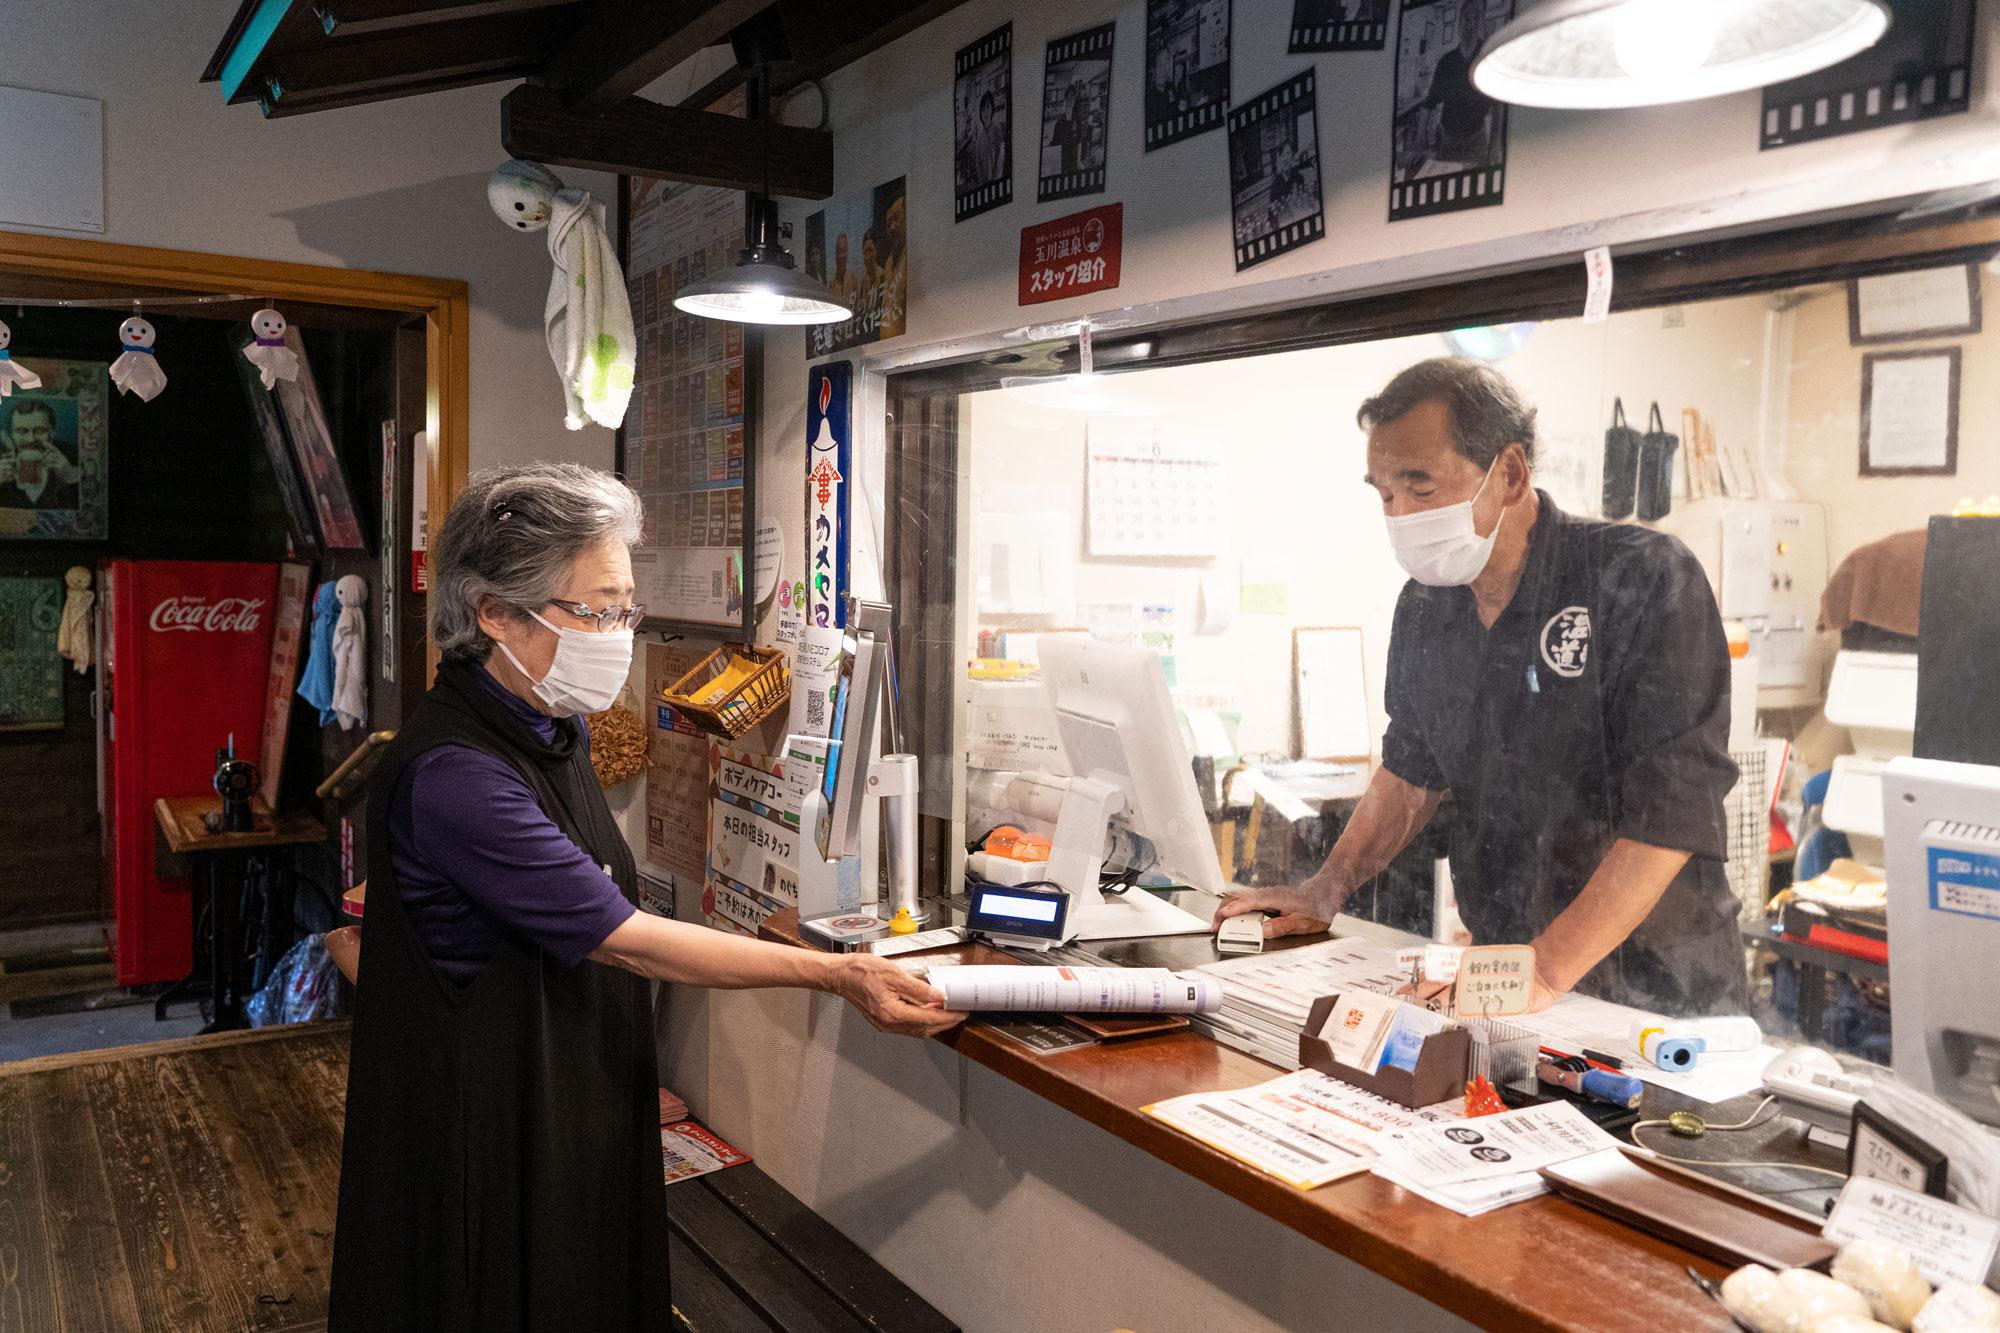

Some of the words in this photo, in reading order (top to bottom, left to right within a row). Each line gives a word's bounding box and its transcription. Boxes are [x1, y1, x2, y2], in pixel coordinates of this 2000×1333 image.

[1034, 236, 1082, 264] 玉川温泉
[1030, 256, 1107, 293] スタッフ紹介
[815, 514, 831, 628] カメヤマ
[149, 597, 266, 633] Coca-Cola
[723, 814, 790, 858] 本日の担当スタッフ
[689, 1129, 732, 1156] イベントカレンダー
